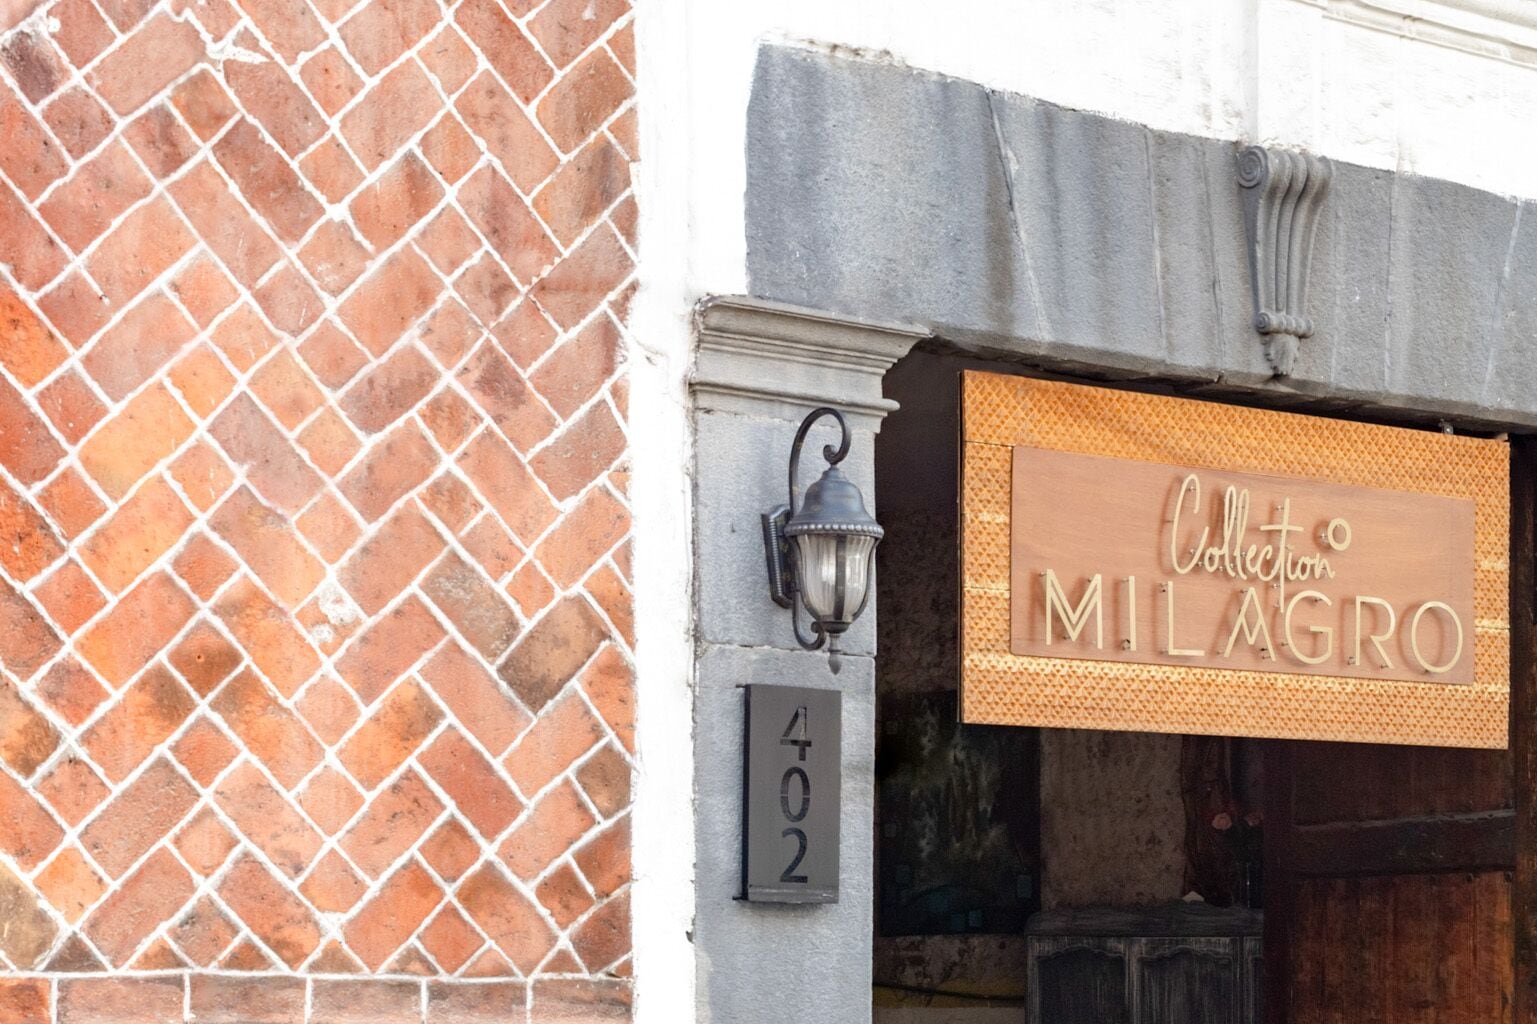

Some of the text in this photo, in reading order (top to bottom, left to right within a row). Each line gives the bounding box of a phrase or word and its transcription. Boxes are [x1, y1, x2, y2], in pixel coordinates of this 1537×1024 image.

[1171, 473, 1336, 613] Collection
[1045, 568, 1463, 674] MILAGRO
[780, 705, 812, 884] 402
